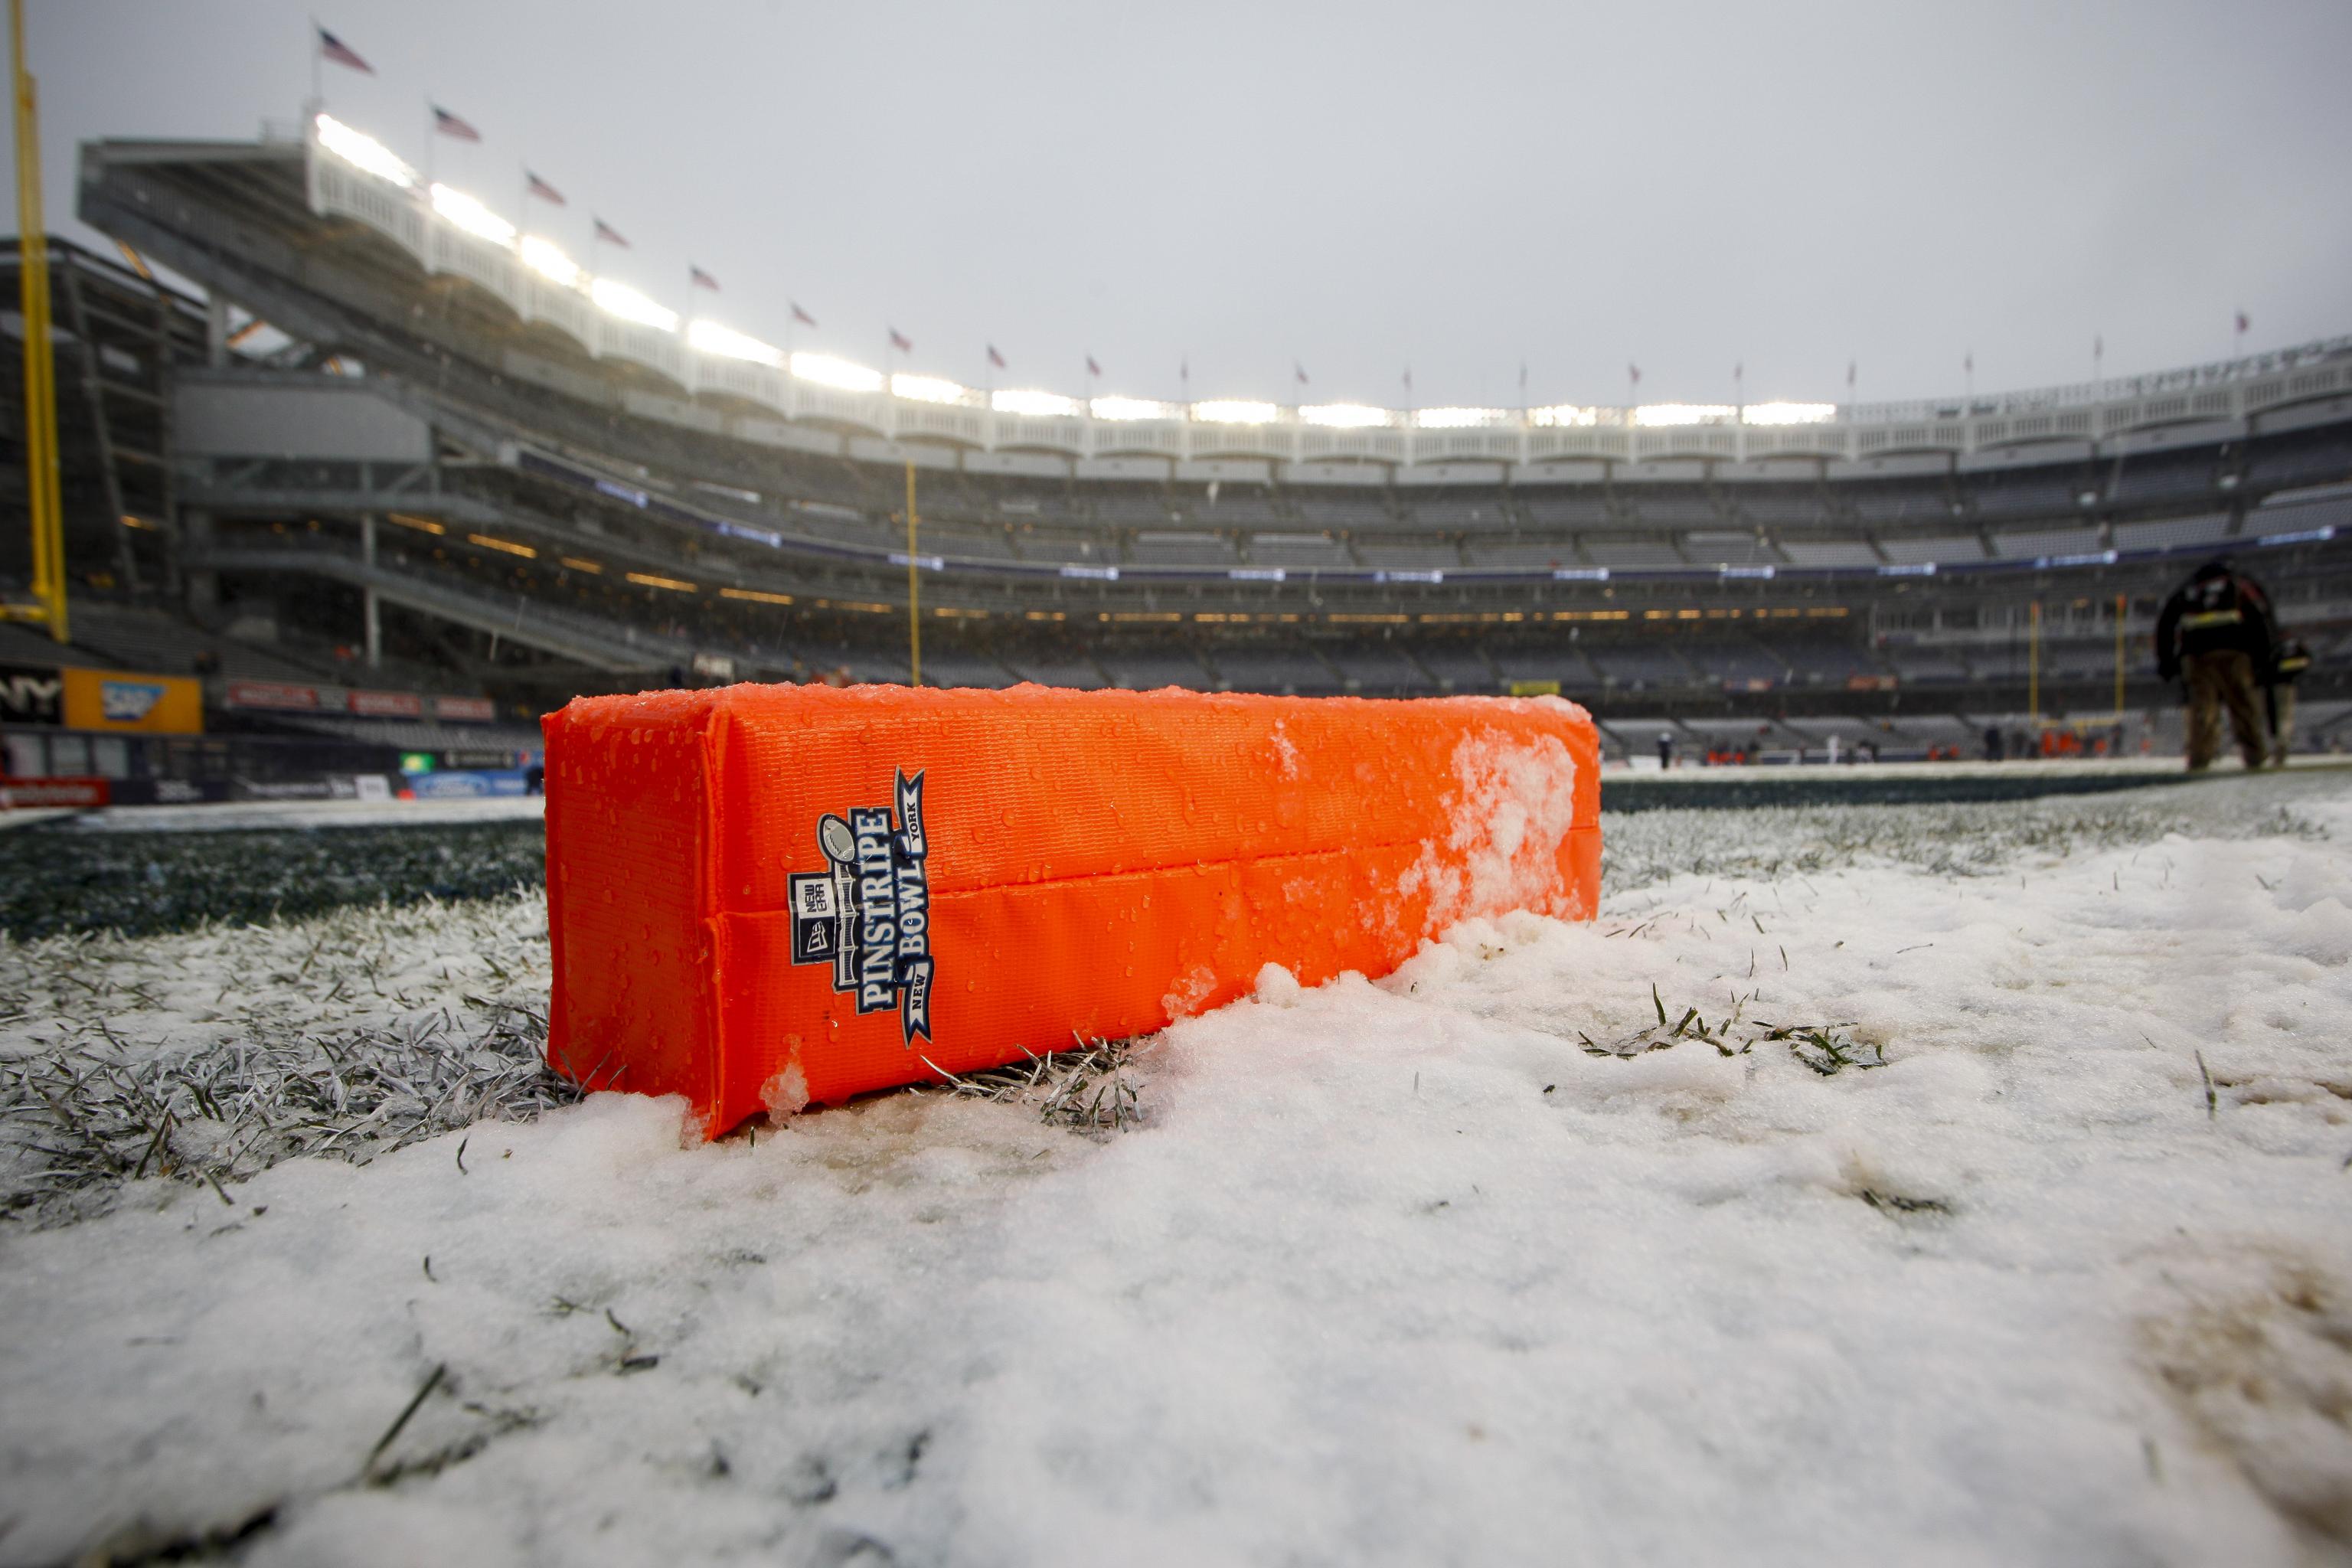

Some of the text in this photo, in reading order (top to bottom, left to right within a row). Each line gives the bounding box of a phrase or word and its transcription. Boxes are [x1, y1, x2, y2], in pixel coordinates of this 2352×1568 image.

[804, 884, 817, 913] NEW
[815, 883, 828, 913] ERA
[855, 814, 896, 1008] PINSTRIPE
[897, 859, 925, 957] BOWL
[906, 802, 926, 1011] NEW YORK
